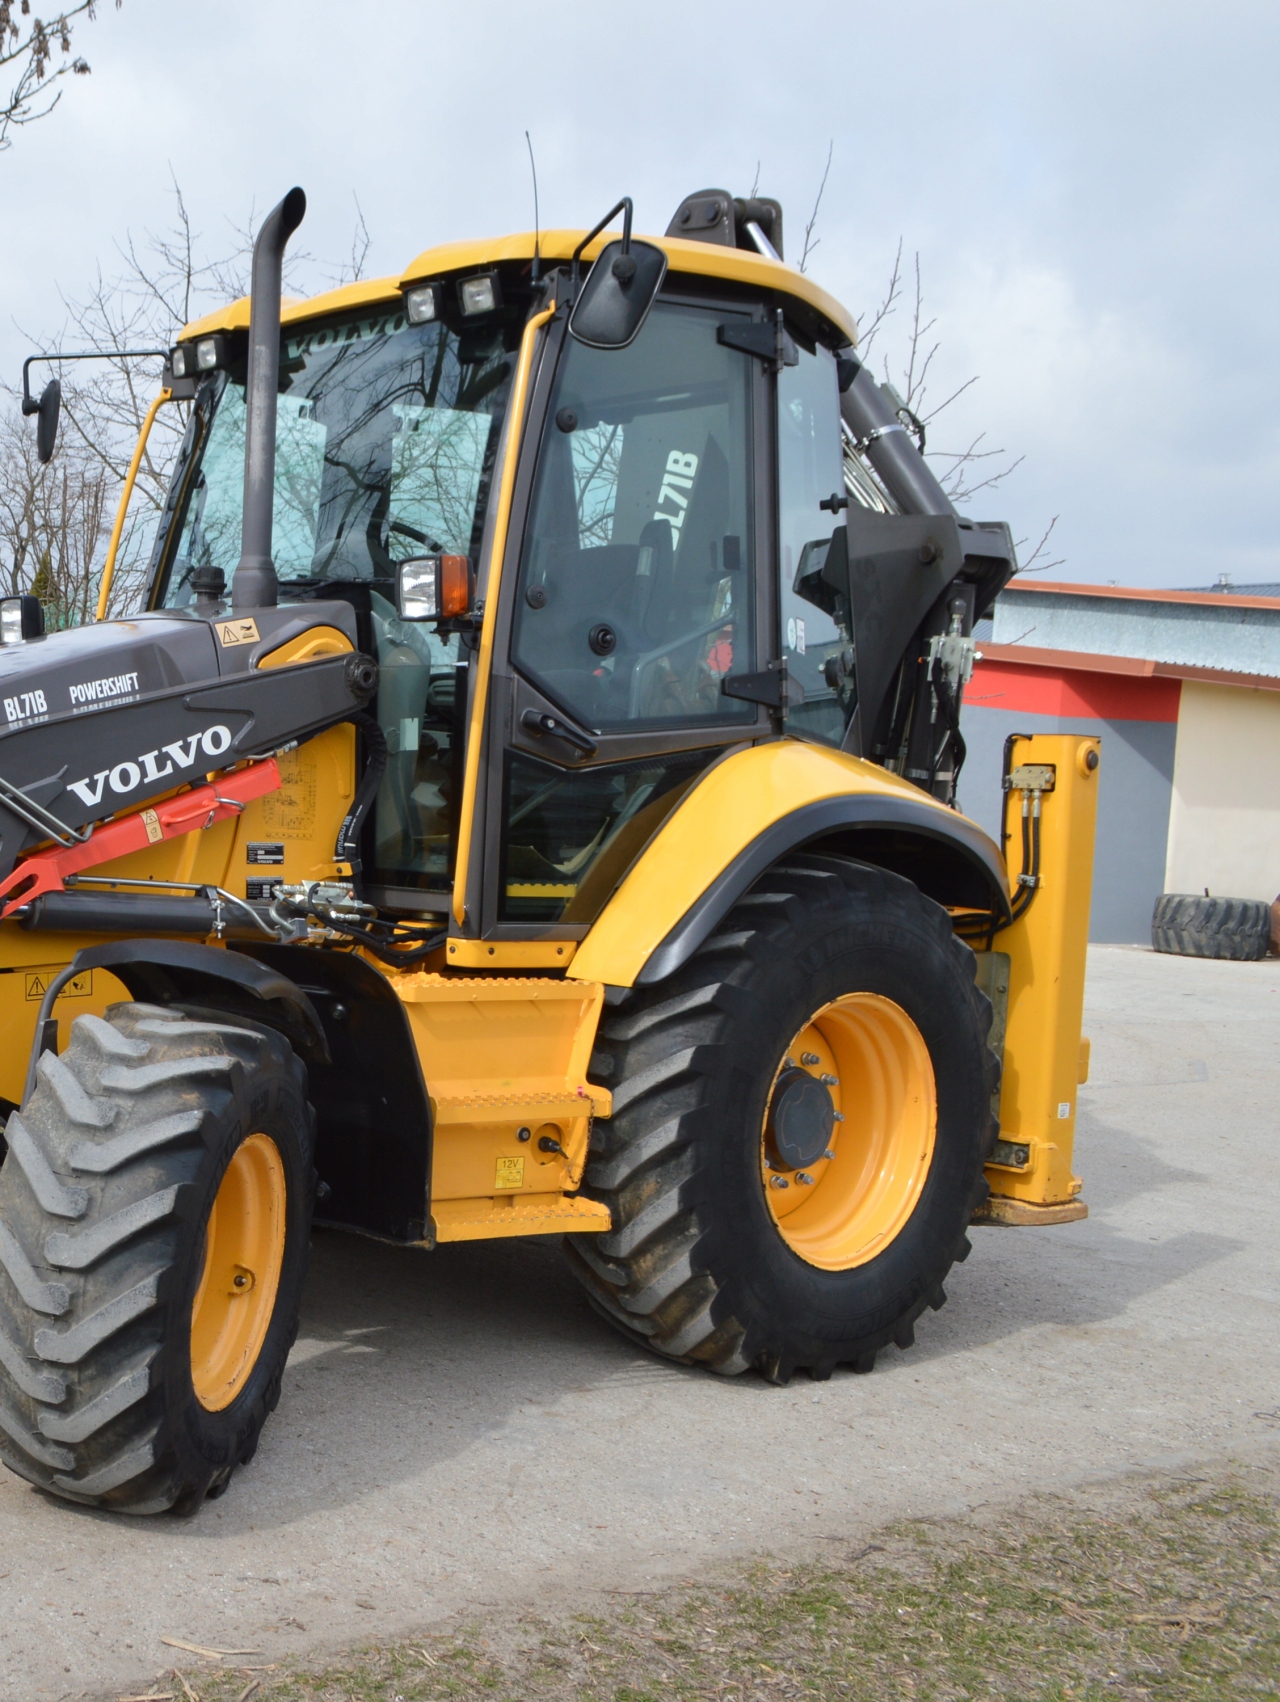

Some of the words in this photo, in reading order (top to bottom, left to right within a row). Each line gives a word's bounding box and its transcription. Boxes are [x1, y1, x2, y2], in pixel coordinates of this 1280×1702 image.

[285, 313, 409, 359] VOLVO
[3, 689, 48, 722] BL71B
[69, 672, 139, 704] POWERSHIFT
[67, 725, 232, 807] VOLVO
[503, 1158, 520, 1169] 12V
